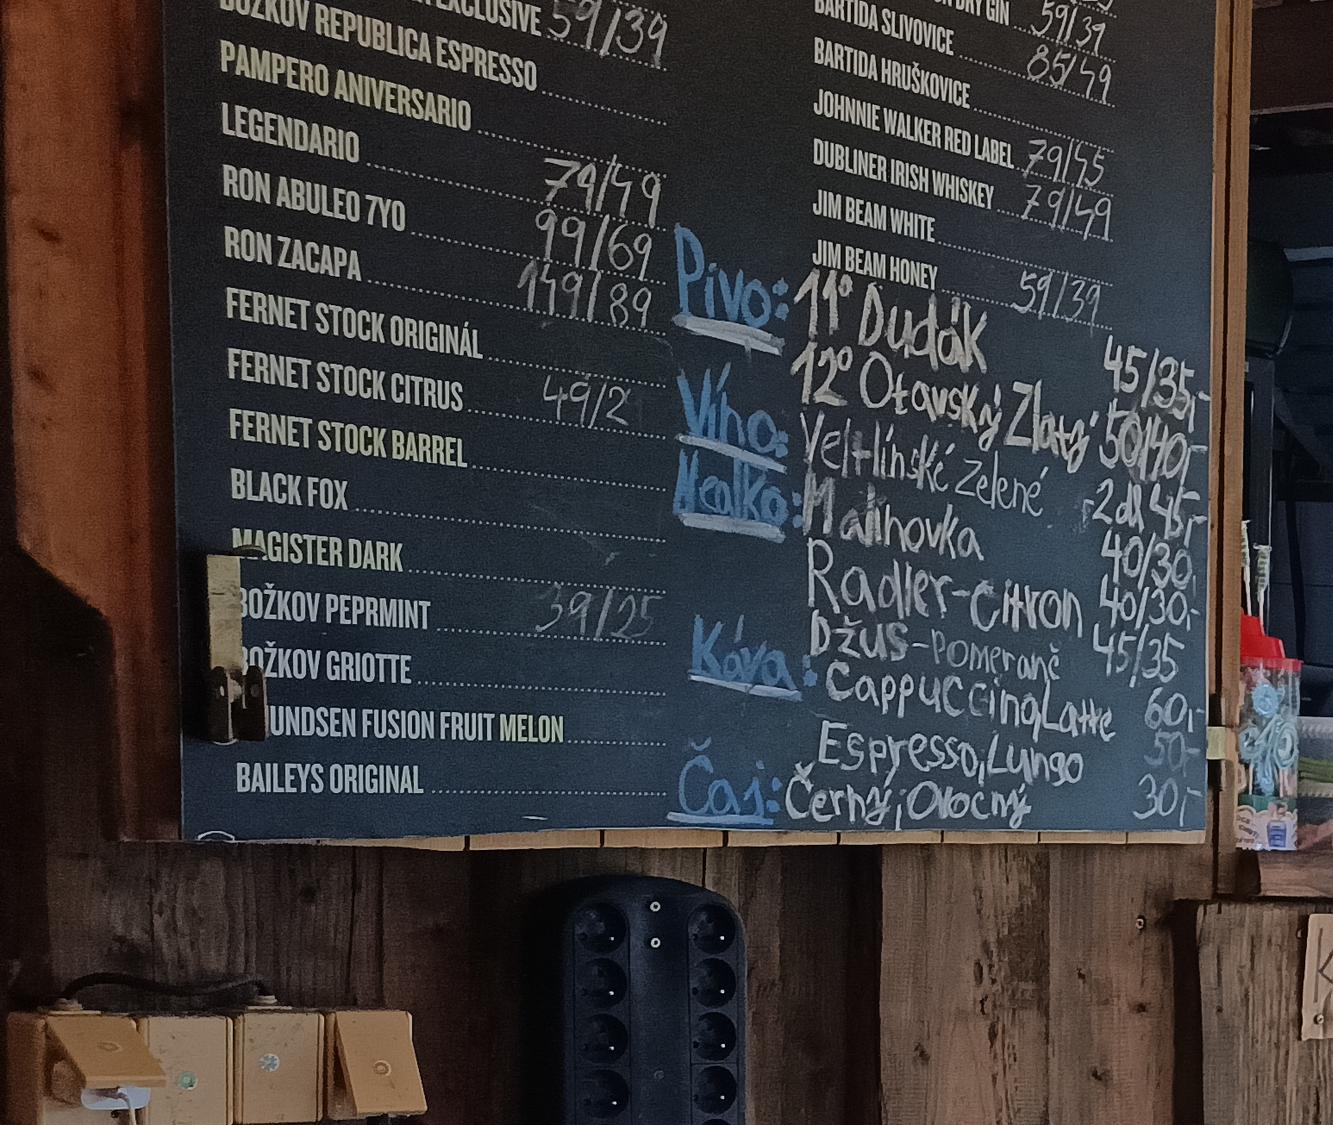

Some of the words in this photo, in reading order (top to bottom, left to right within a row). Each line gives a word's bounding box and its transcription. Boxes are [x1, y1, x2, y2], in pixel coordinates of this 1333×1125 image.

[315, 3, 432, 64] REPUBLICA
[436, 36, 538, 91] ESPRESSO
[881, 8, 954, 56] SLIVOVICE
[220, 39, 329, 97] PAMPERO
[335, 69, 472, 131] ANIVERSARIO
[814, 37, 878, 82] BARTIDA
[881, 61, 971, 109] HRUŠKOVICE
[221, 103, 360, 163] LEGENDARIO
[814, 89, 880, 132] JOHNNIE
[883, 106, 942, 149] WALKER
[945, 120, 974, 155] RED
[975, 127, 1015, 169] LABEL
[813, 138, 888, 183] DUBLINER
[891, 157, 929, 193] IRISH
[932, 167, 995, 210] WHISKEY
[223, 164, 271, 203] RON
[276, 174, 360, 223] ABULEO
[535, 208, 652, 281] 99/69
[813, 190, 842, 220] JIM
[845, 196, 888, 231] BEAM
[890, 207, 936, 243] WHITE
[225, 226, 273, 264] RON
[277, 236, 361, 282] ZACAPA
[812, 239, 842, 269] JIM
[845, 246, 887, 279] BEAM
[890, 256, 938, 291] HONEY
[226, 287, 311, 334] FERNET
[315, 302, 385, 345] STOCK
[390, 320, 483, 361] ORIGINÁL
[674, 223, 790, 329] Pivo:
[858, 282, 987, 374] Dudák
[227, 347, 312, 389] FERNET
[316, 362, 386, 402] STOCK
[390, 374, 464, 412] CITRUS
[229, 408, 313, 449] FERNET
[317, 421, 387, 459] STOCK
[391, 431, 468, 468] BARREL
[230, 469, 302, 505] BLACK
[307, 478, 349, 511] FOX
[349, 538, 404, 572] DARK
[325, 592, 431, 630] PEPRMINT
[326, 650, 412, 685] GRIOTTE
[267, 704, 356, 739] UNDSEN
[362, 708, 435, 740] FUSION
[439, 711, 495, 742] FRUIT
[500, 714, 564, 744] MELON
[236, 762, 324, 793] BAILEYS
[329, 763, 424, 795] ORIGINAL
